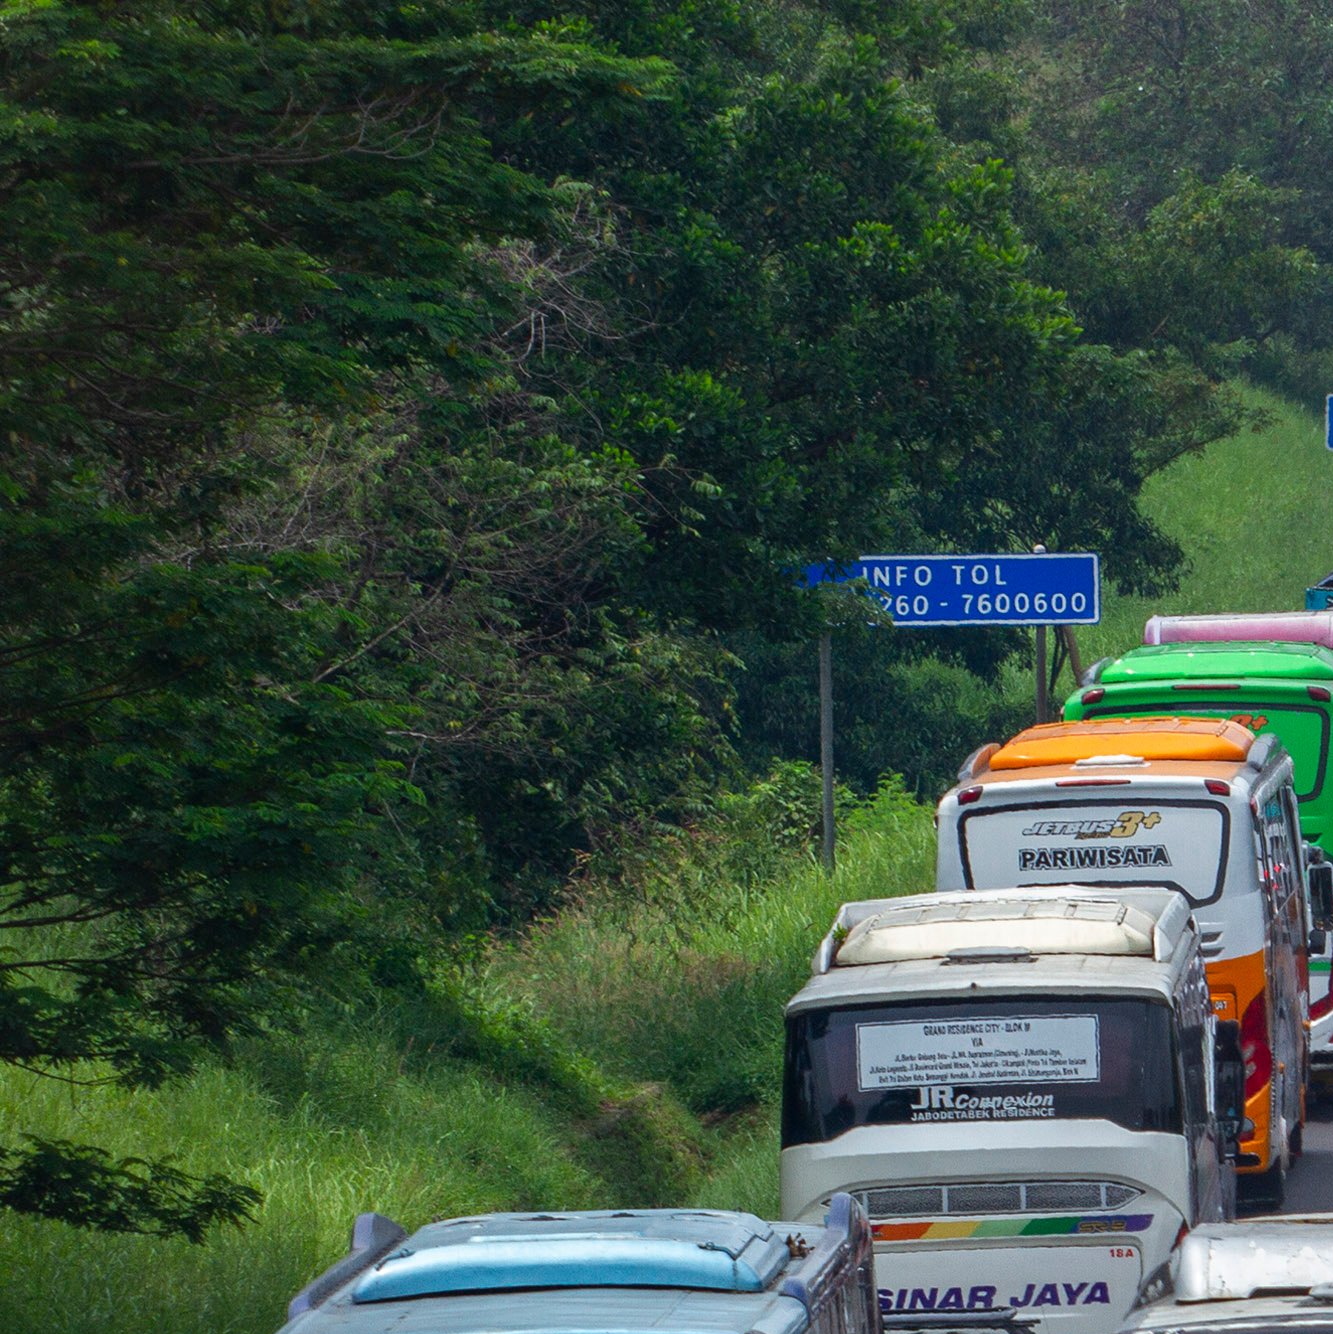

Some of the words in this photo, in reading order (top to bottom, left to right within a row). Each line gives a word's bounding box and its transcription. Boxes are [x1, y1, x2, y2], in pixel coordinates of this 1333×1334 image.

[862, 564, 932, 588] INFO
[952, 563, 1007, 586] TOL
[962, 591, 1087, 615] 7600600
[1019, 845, 1173, 872] PARIWISATA
[984, 1022, 1000, 1033] CITY
[911, 1085, 955, 1110] JR
[954, 1092, 1054, 1111] Connexion
[911, 1107, 990, 1122] JABODETABEK
[993, 1106, 1055, 1119] RESIDENCE
[877, 1285, 997, 1310] SINAR
[1010, 1281, 1110, 1308] JAYA
